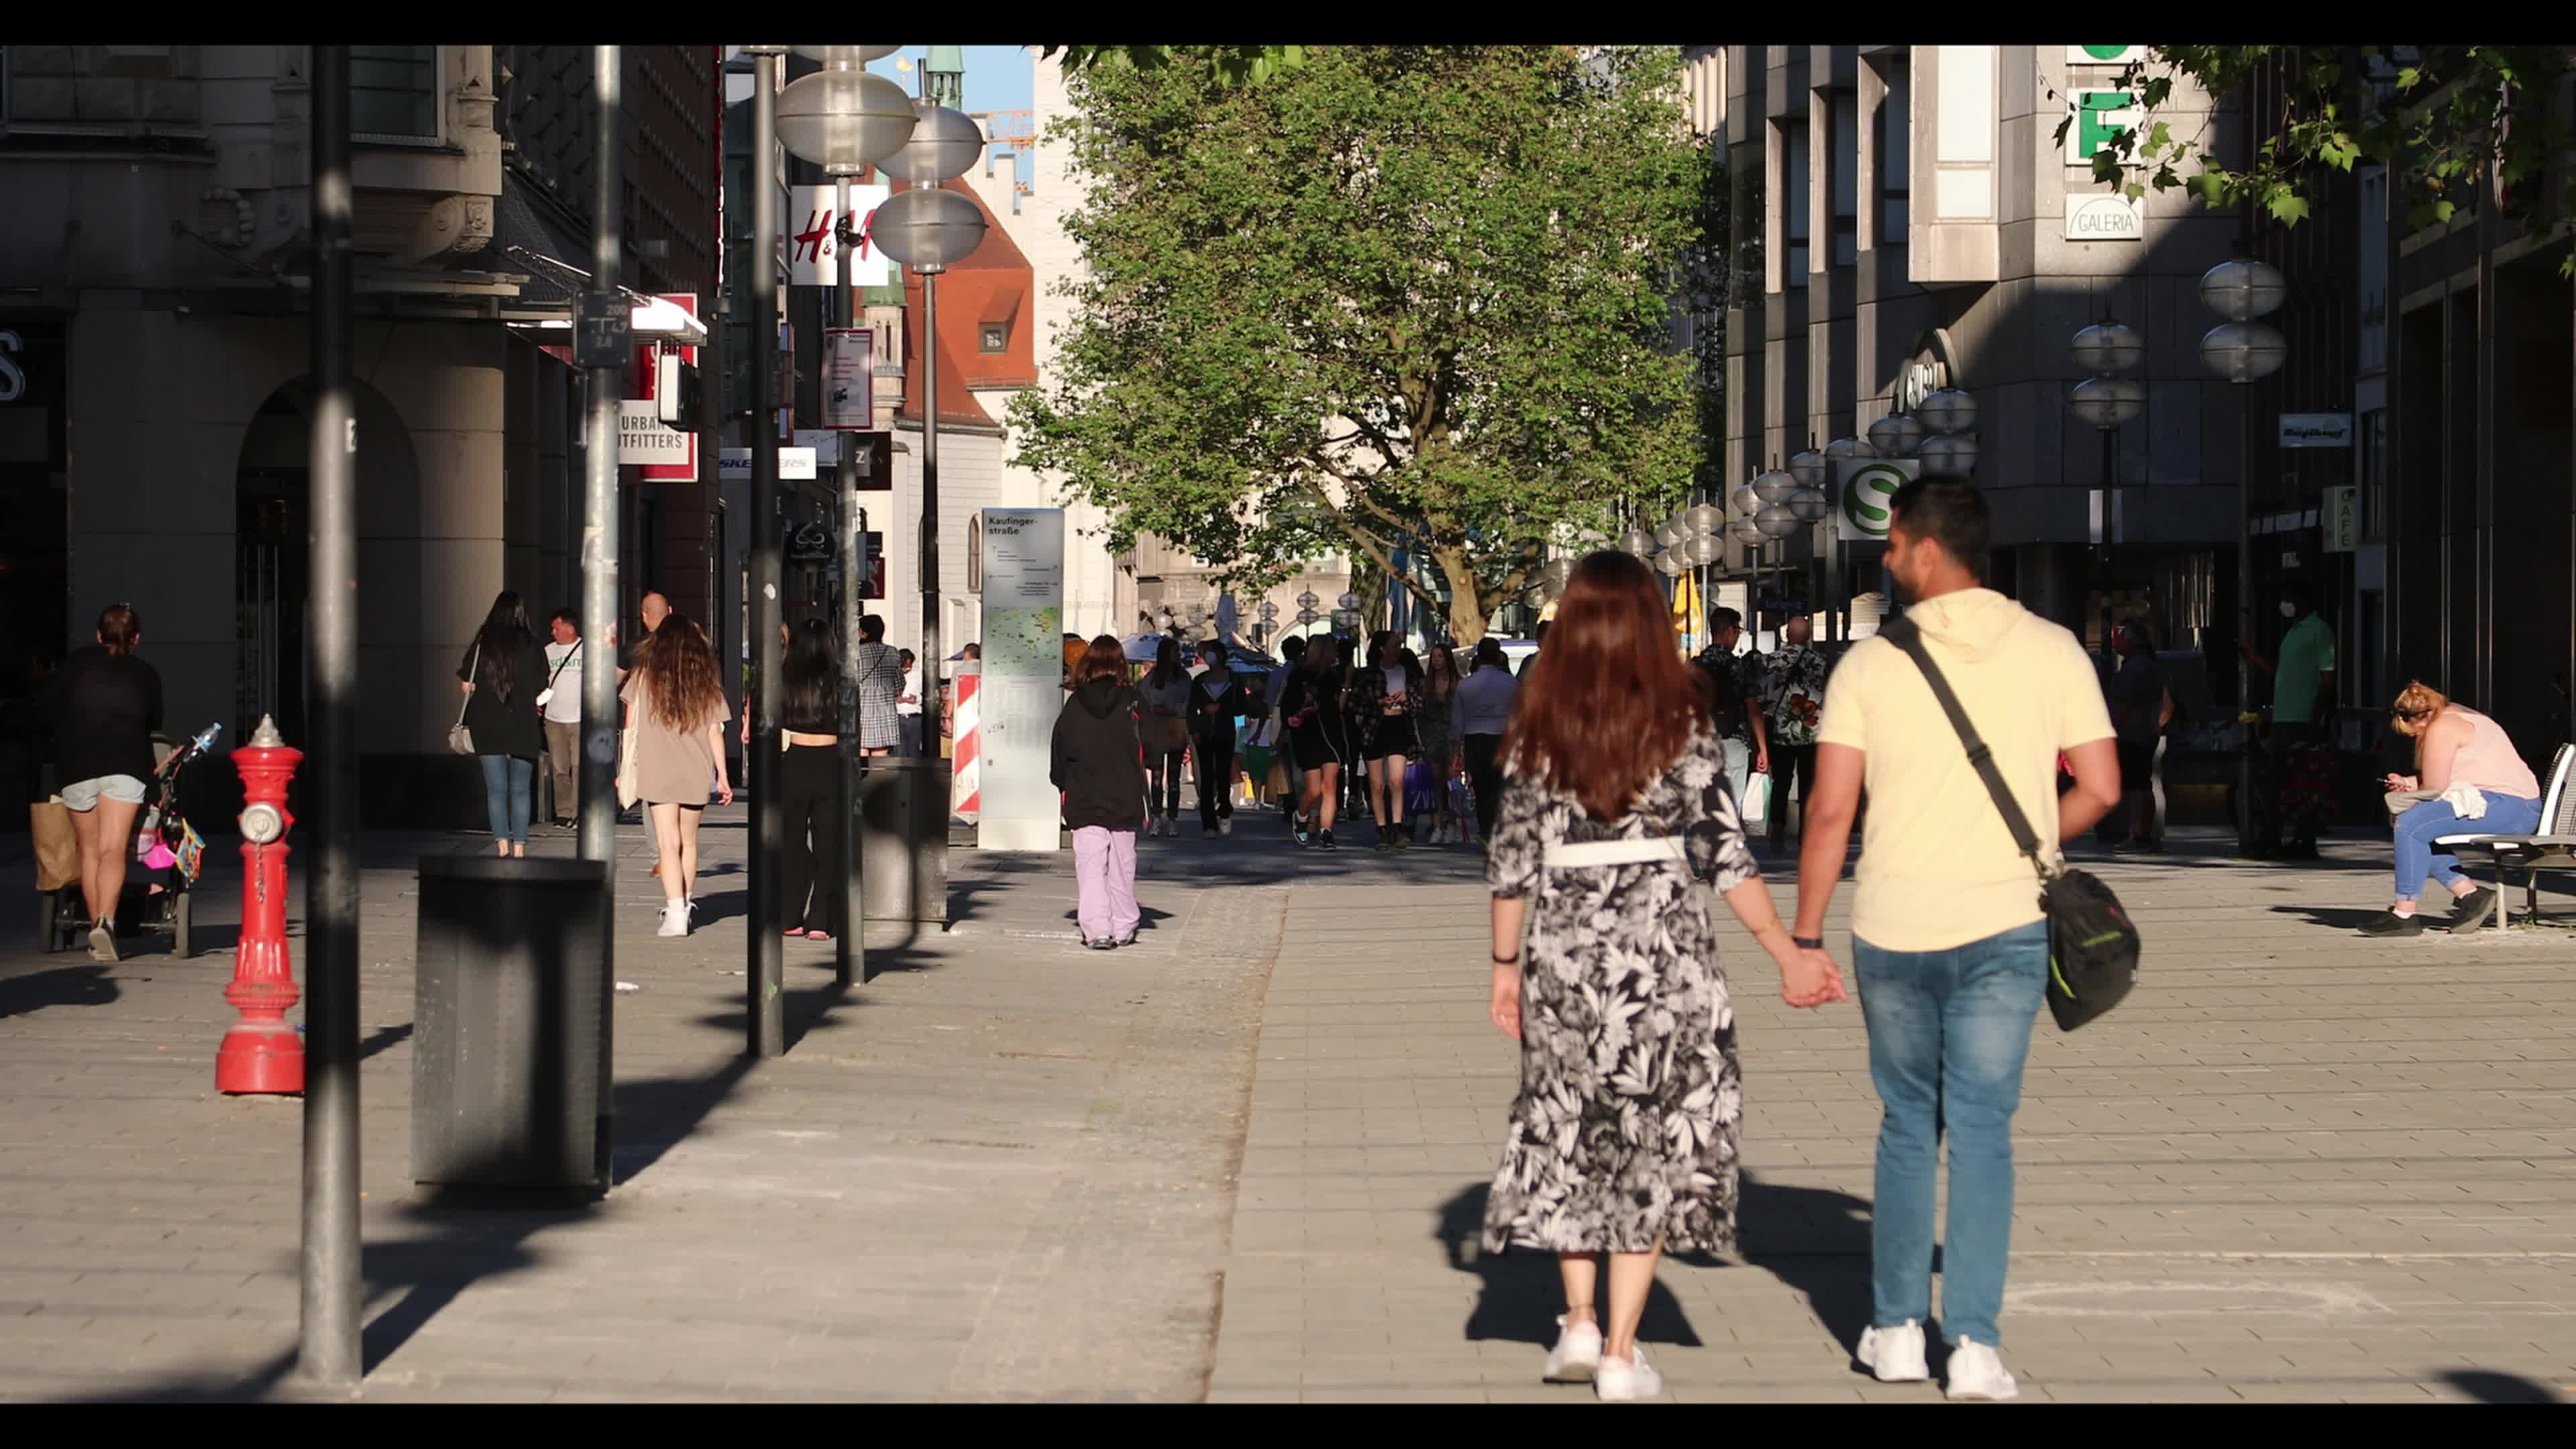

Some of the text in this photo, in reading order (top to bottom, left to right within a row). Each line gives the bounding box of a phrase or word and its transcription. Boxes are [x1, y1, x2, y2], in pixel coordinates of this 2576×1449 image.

[2078, 214, 2134, 232] GALERIA
[606, 305, 627, 315] 200
[618, 434, 682, 448] TFITTERS
[1856, 471, 1900, 529] S
[988, 527, 1020, 535] straße
